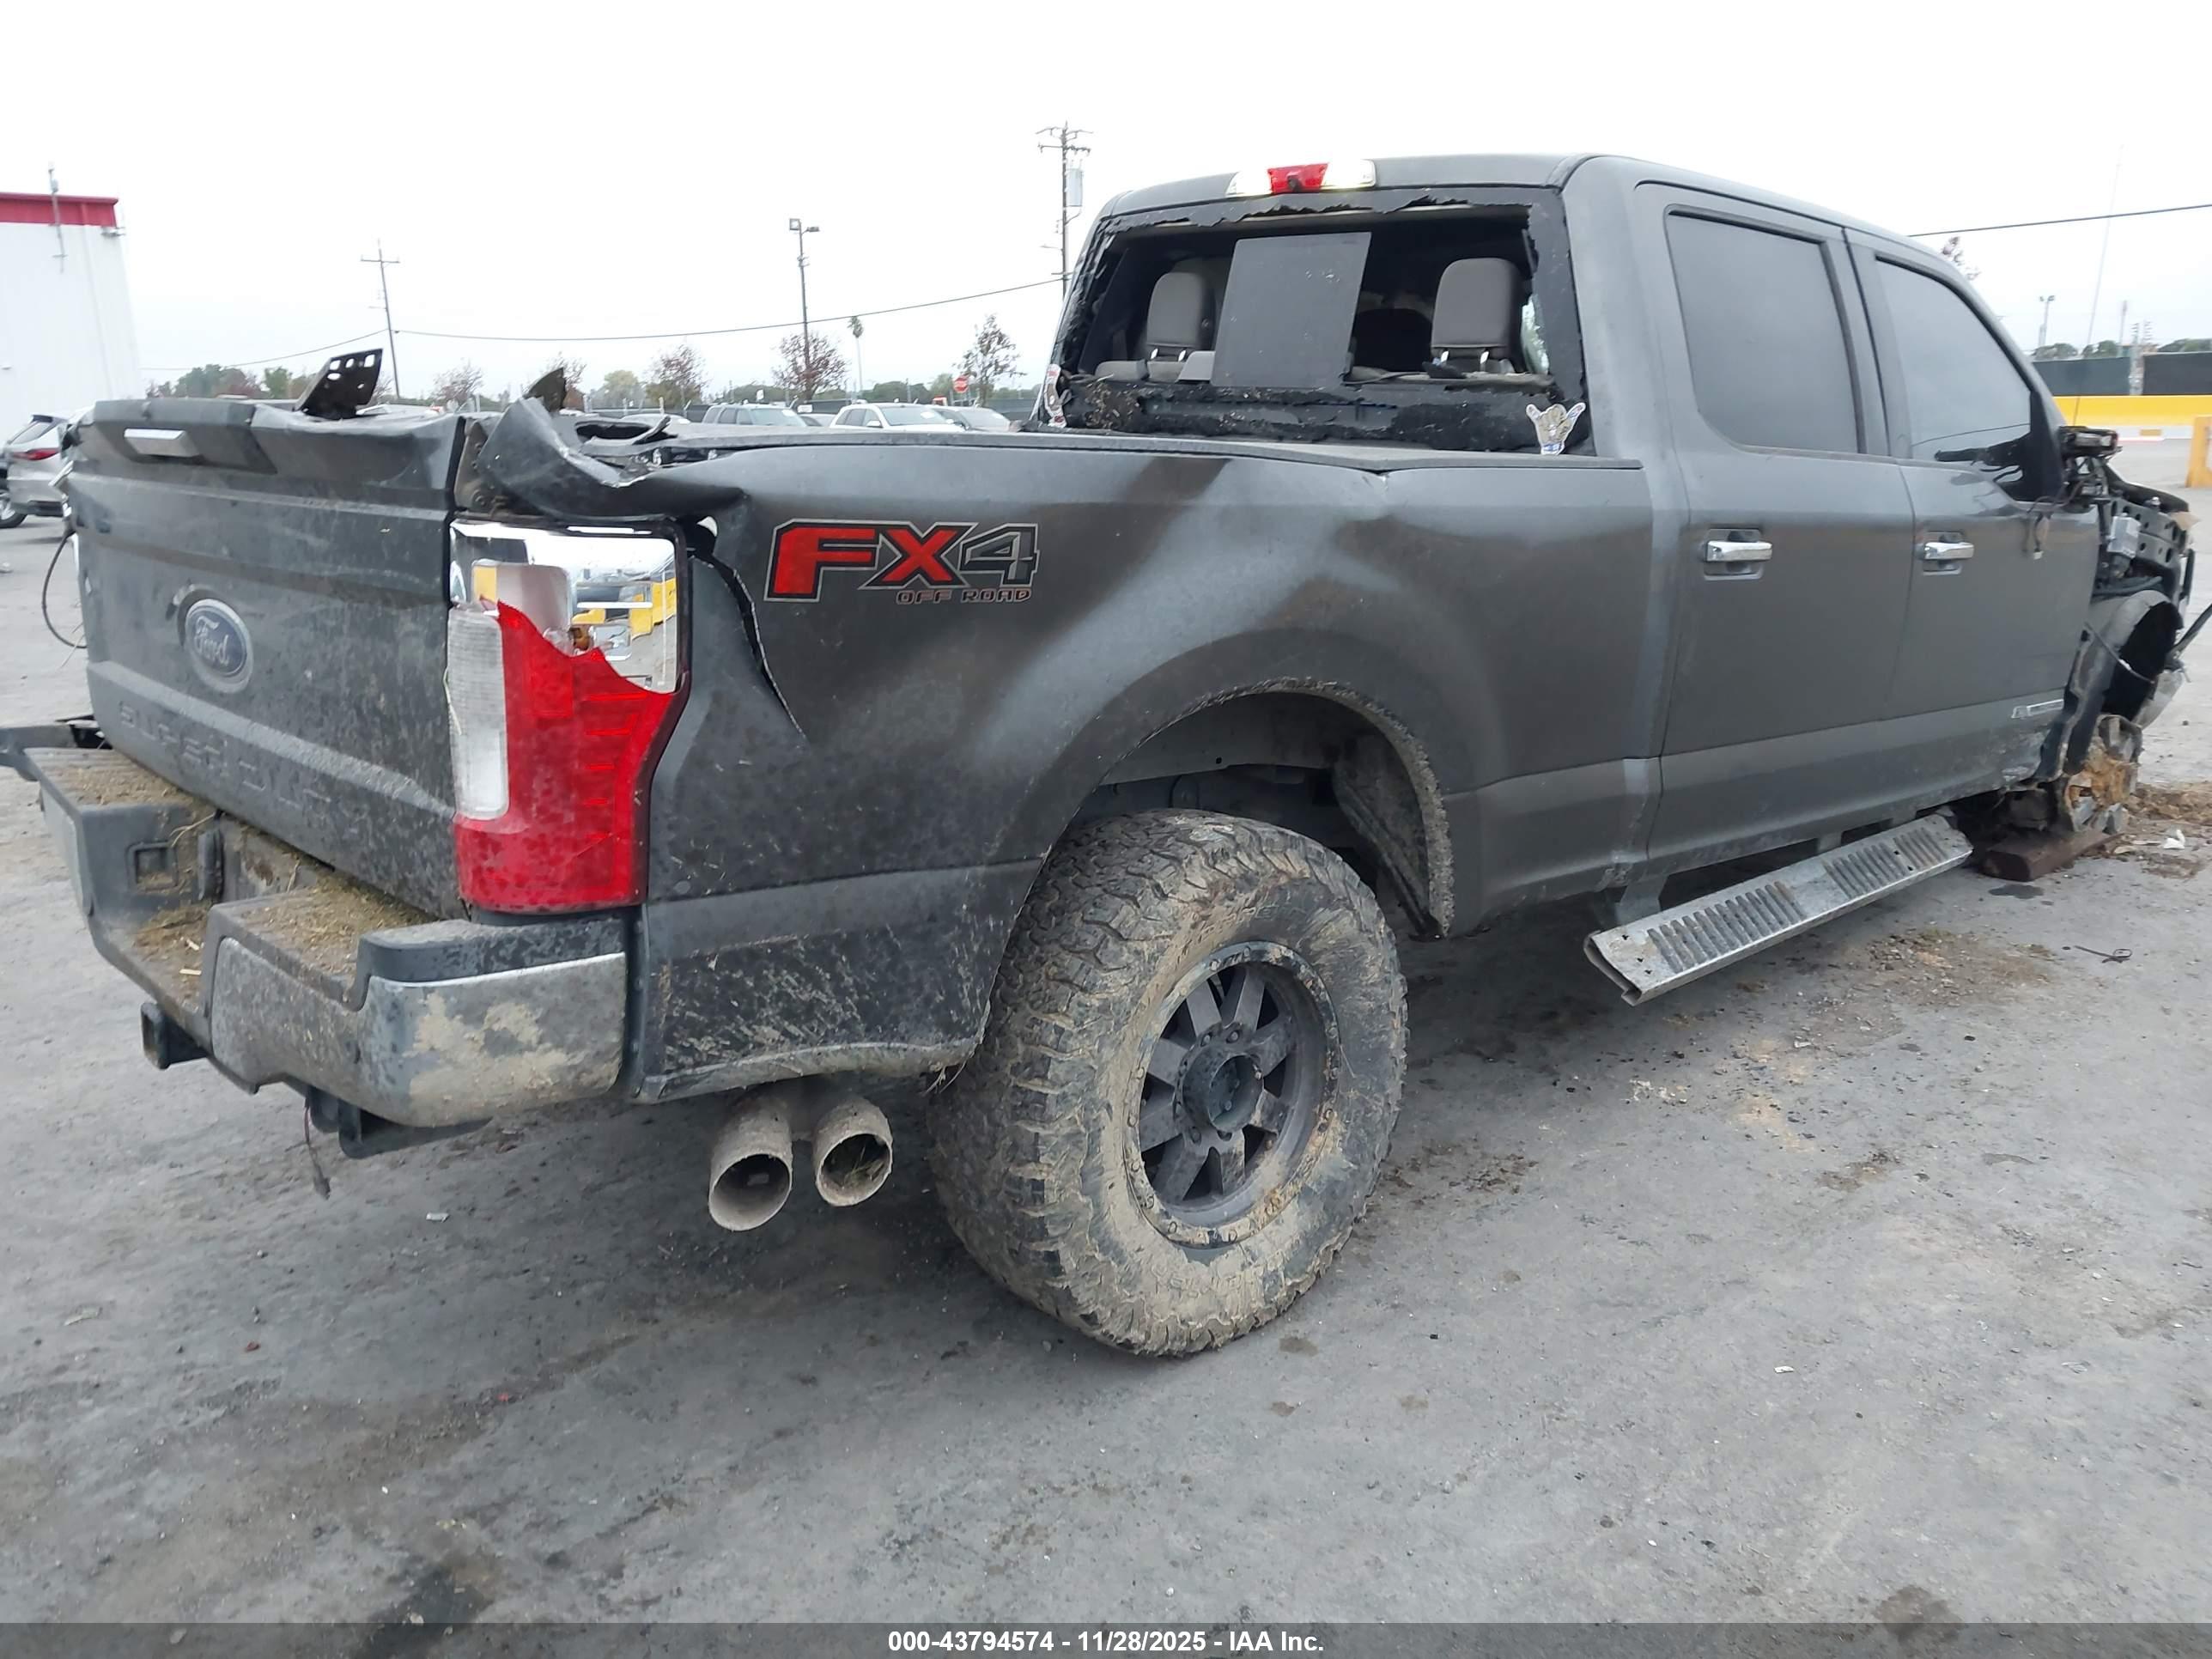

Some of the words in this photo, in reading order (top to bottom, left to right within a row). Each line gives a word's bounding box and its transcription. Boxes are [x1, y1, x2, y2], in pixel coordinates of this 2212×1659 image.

[763, 518, 1040, 602] FX4
[896, 590, 952, 605] OFF
[961, 588, 1031, 603] ROAD
[193, 615, 229, 666] Ford
[118, 701, 227, 773] SUPER
